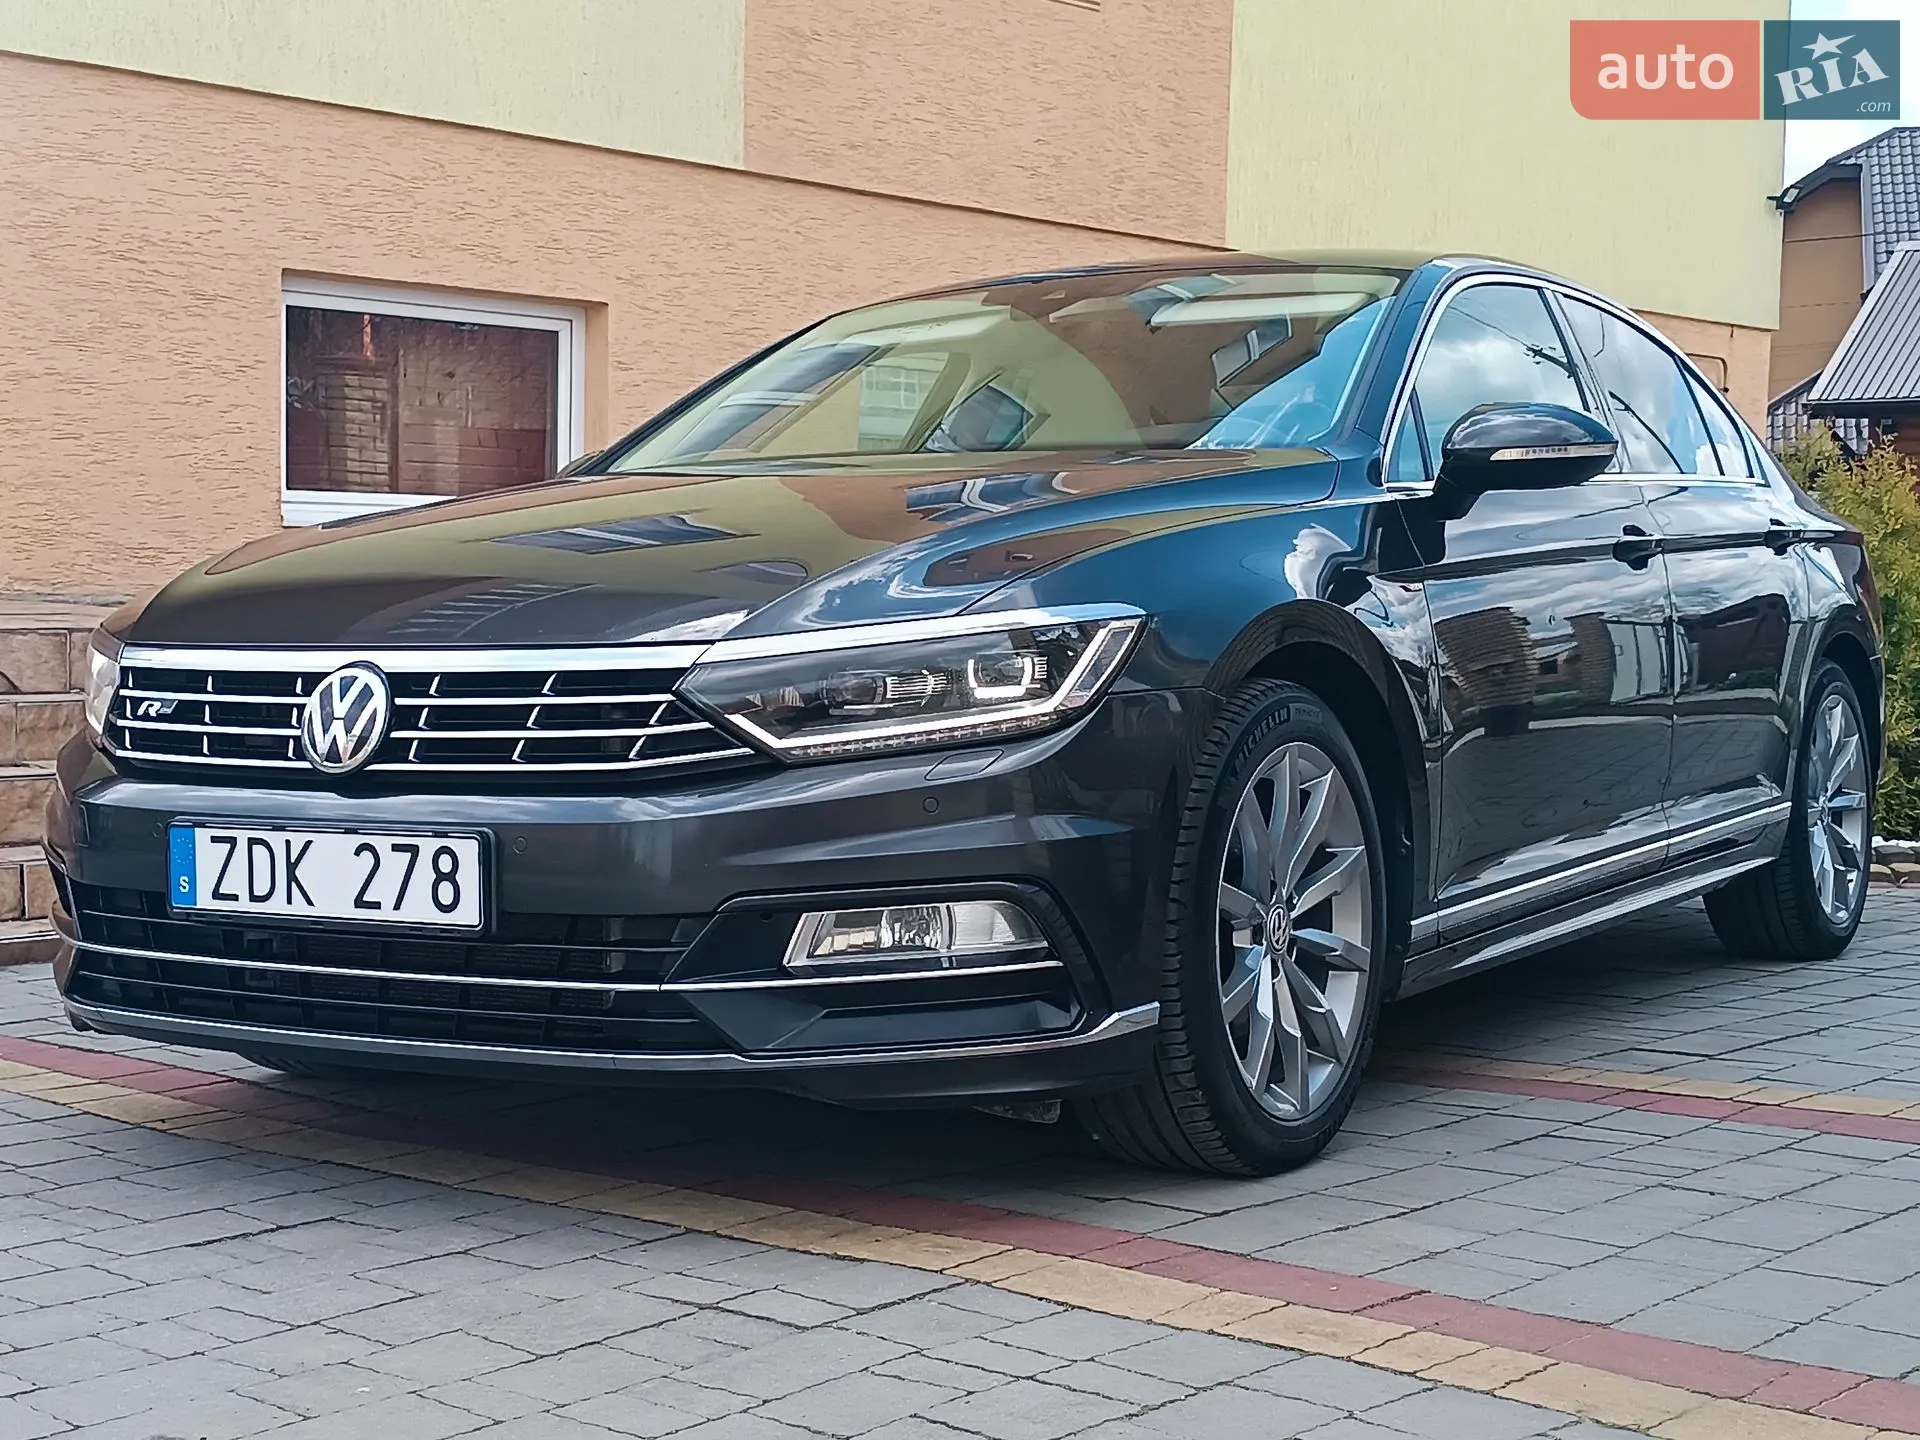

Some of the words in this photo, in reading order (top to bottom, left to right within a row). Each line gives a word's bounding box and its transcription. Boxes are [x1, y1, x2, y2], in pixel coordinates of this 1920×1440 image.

[1233, 706, 1289, 776] MICHELIN
[179, 876, 189, 893] S
[210, 835, 315, 907] ZDK
[353, 842, 461, 913] 278
